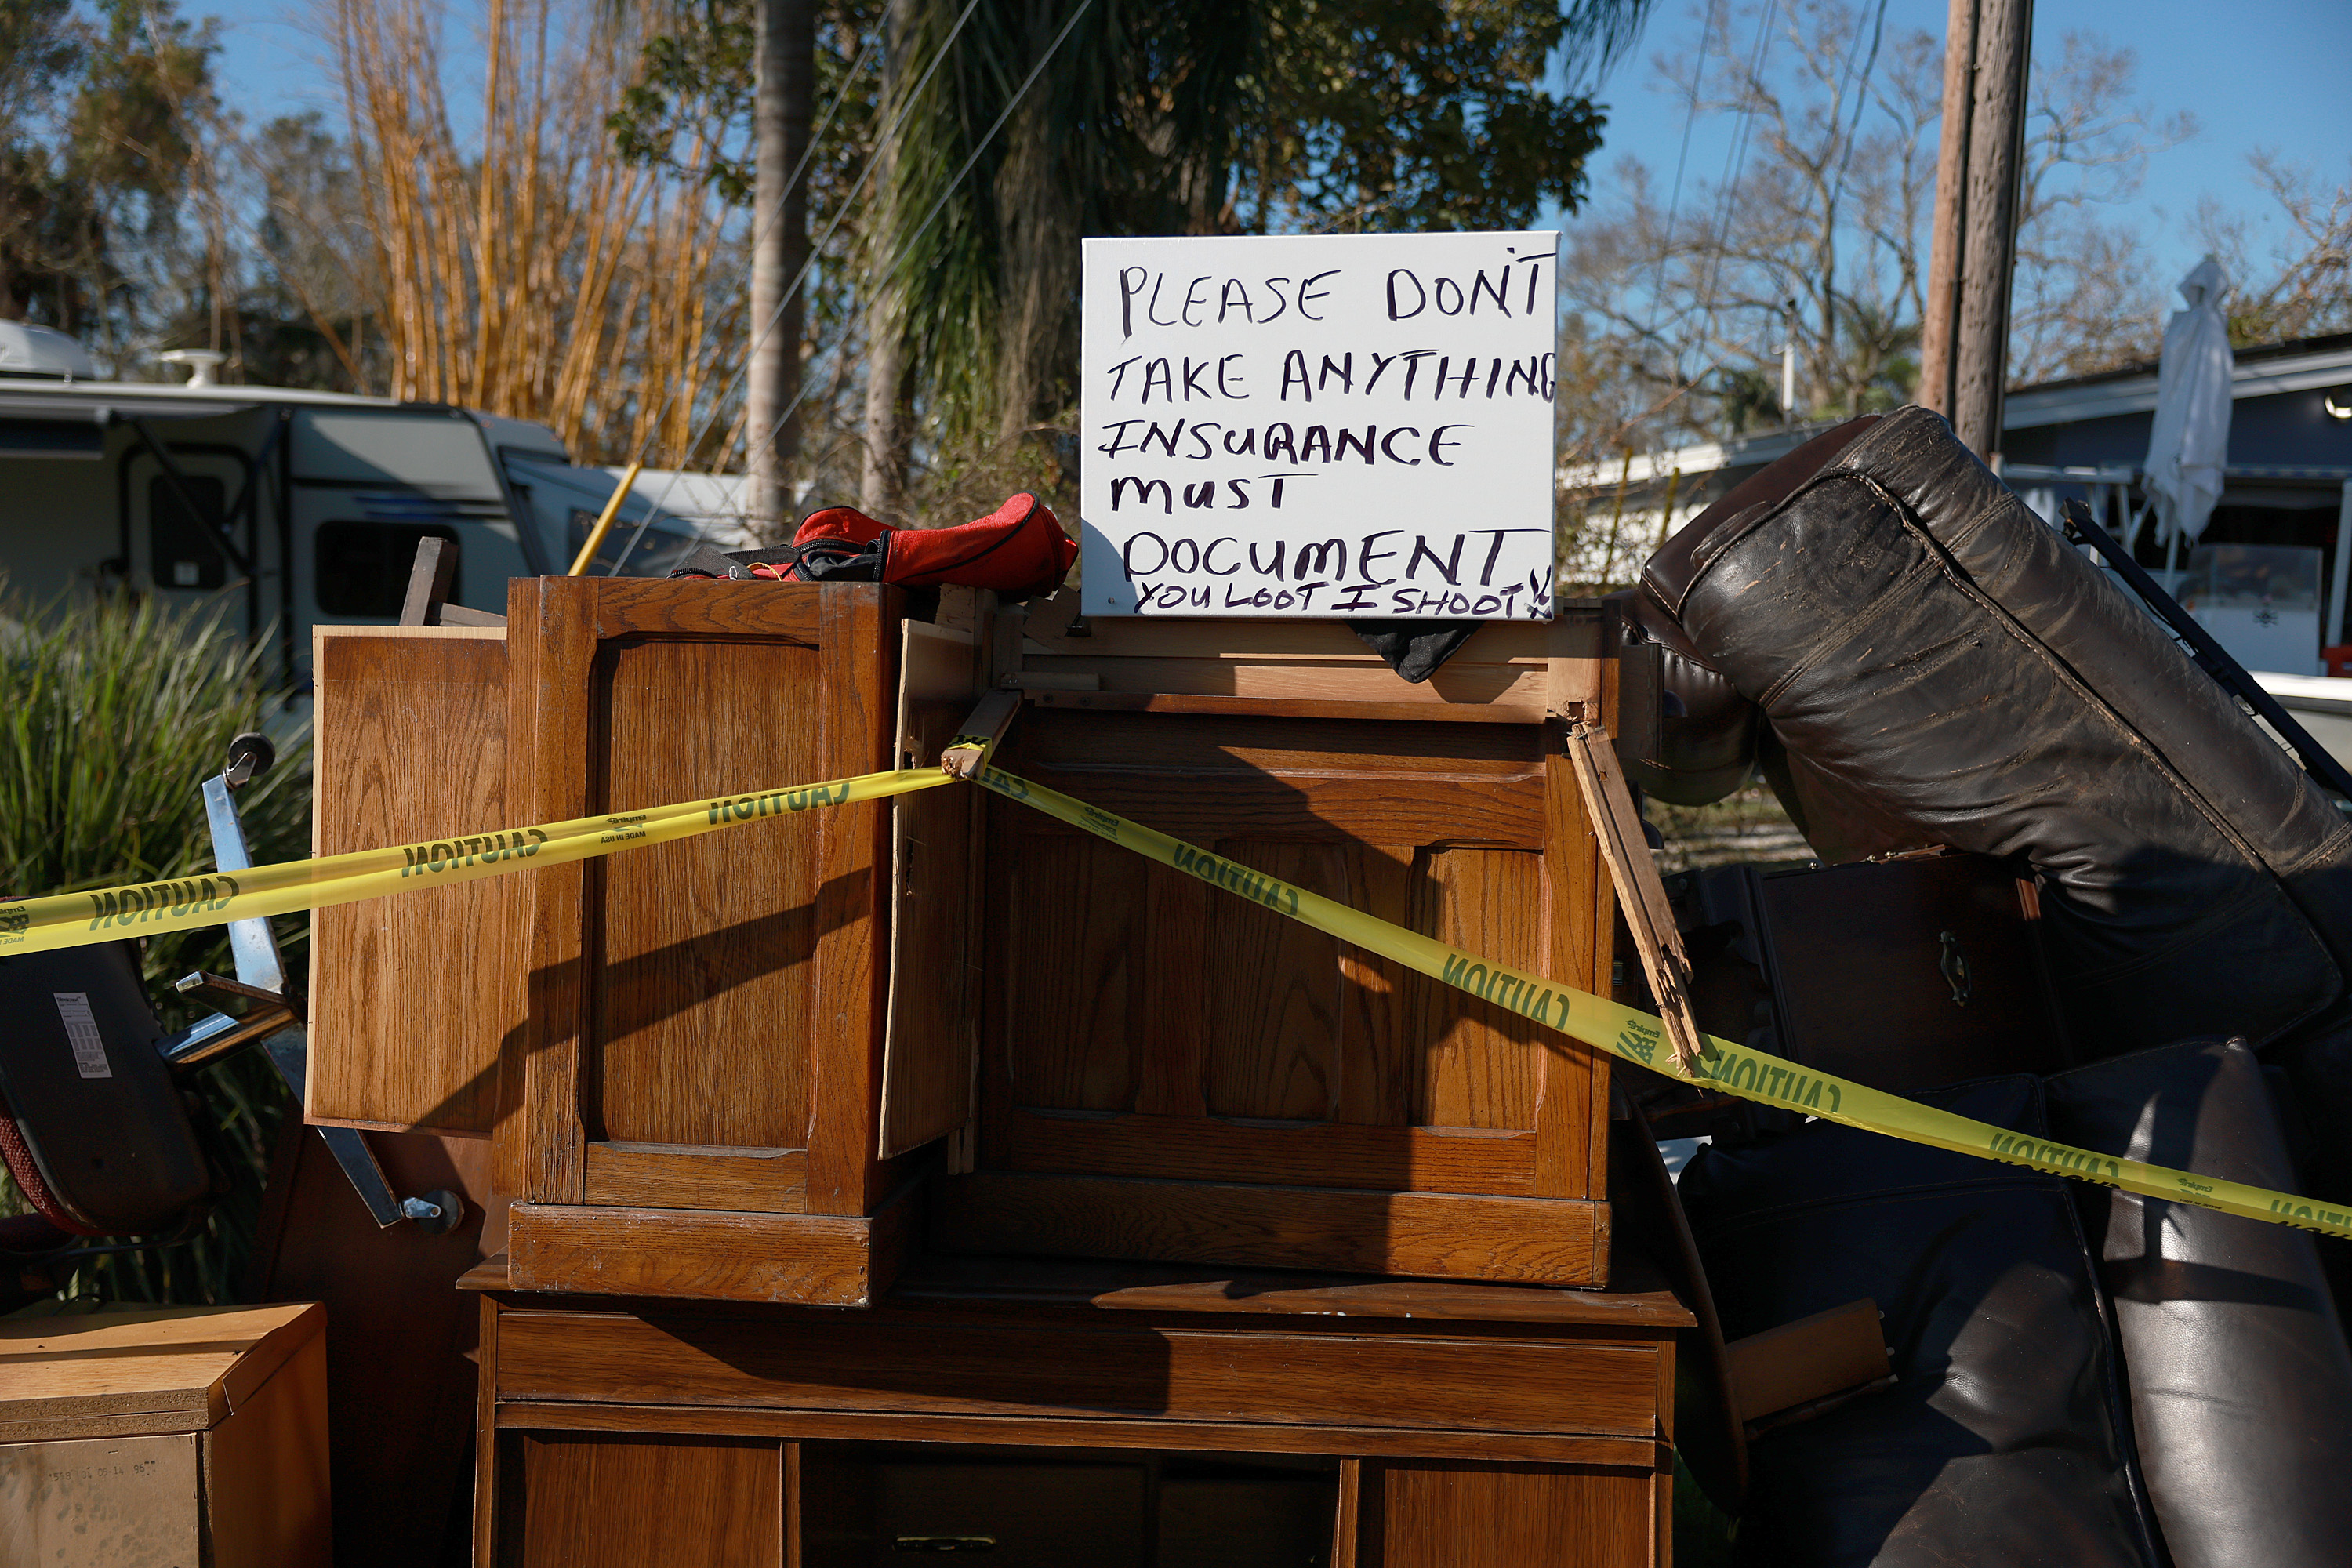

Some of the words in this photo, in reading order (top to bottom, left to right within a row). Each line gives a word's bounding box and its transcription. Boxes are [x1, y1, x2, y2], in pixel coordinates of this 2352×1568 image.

[1120, 266, 1341, 343] PLEASE
[1387, 247, 1556, 321] DON'T
[1108, 354, 1250, 405] TAKE
[1281, 349, 1556, 404] ANYTHING
[1098, 419, 1475, 466] INSURANCE
[1123, 529, 1552, 586] DOCUMENT
[1133, 582, 1210, 614] YOU
[1225, 580, 1330, 612] LOOT
[1330, 583, 1382, 612] I
